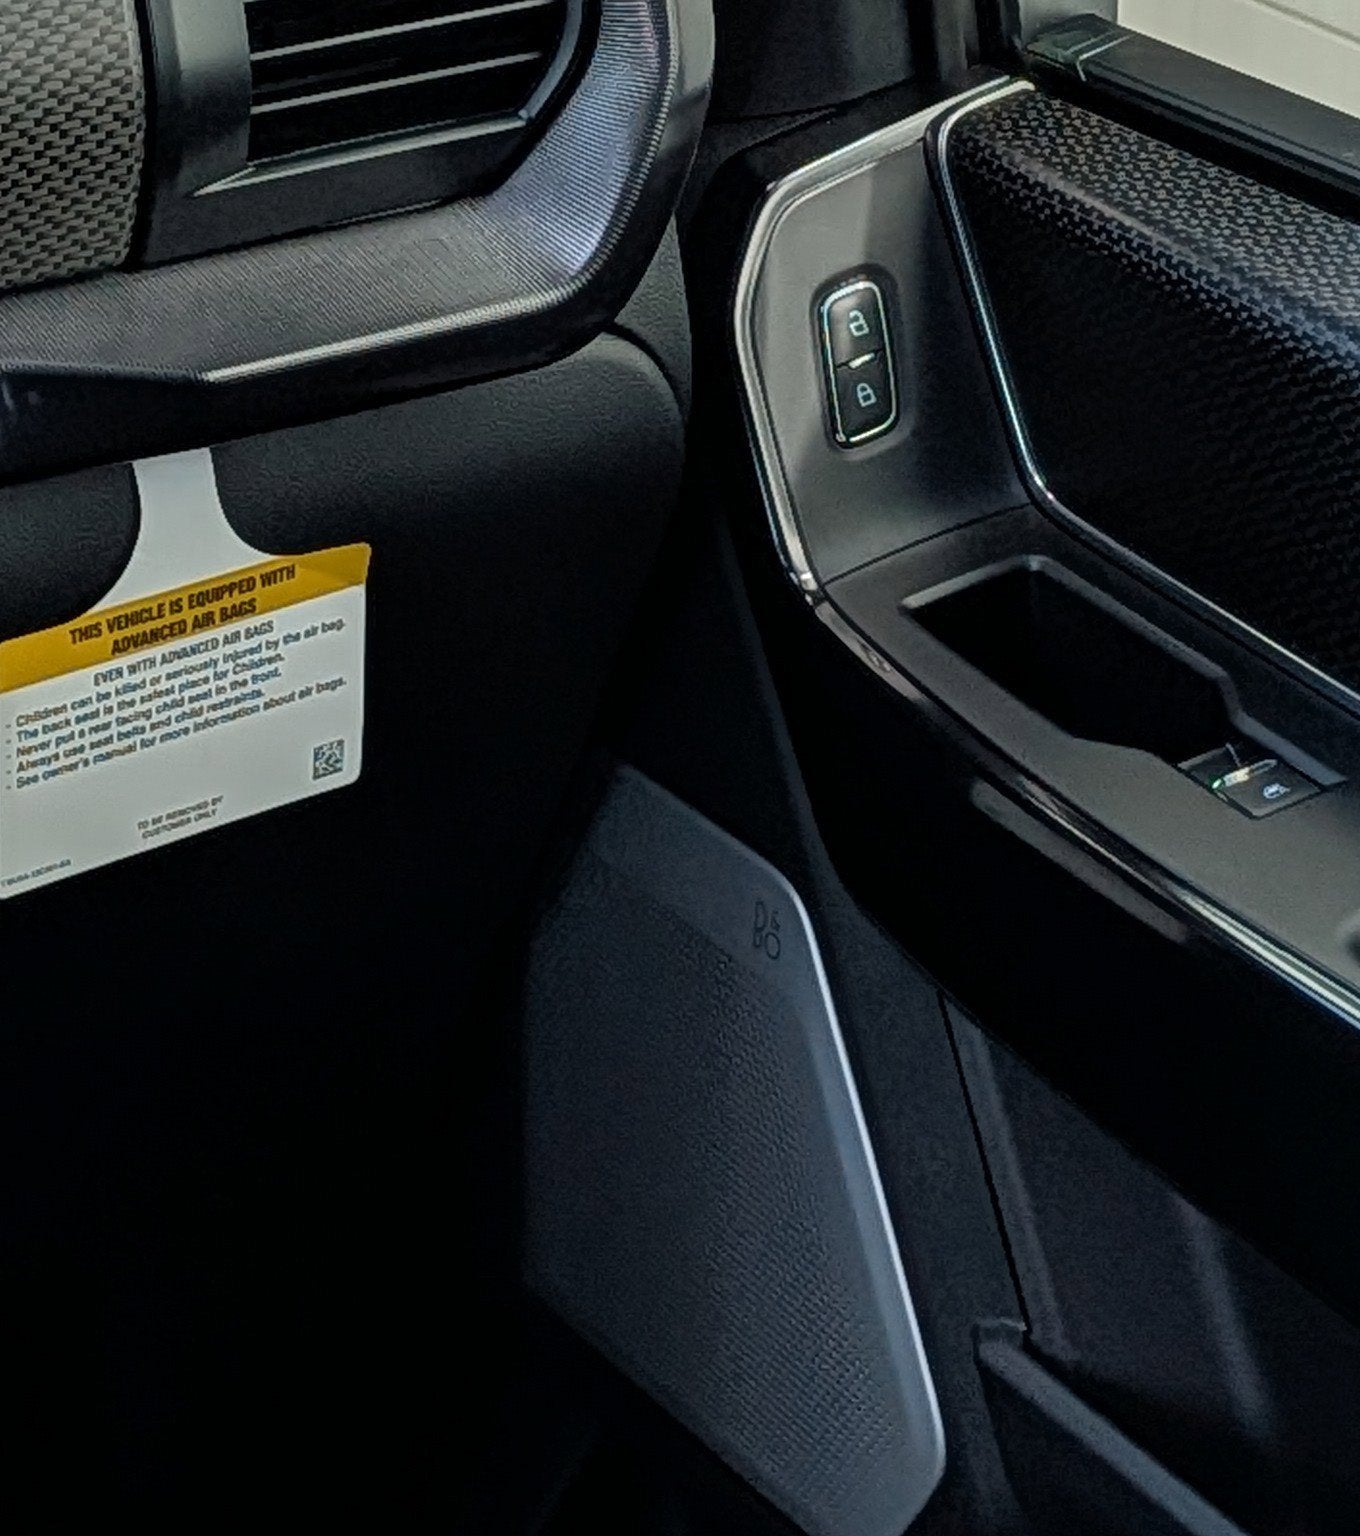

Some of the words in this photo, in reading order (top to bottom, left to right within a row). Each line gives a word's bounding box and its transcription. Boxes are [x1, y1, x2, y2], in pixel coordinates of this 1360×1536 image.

[69, 623, 102, 645] THIS
[106, 603, 166, 633] VEHICLE
[169, 597, 183, 615] IS
[188, 576, 256, 609] EQUIPPED
[260, 564, 295, 588] WITH
[111, 619, 187, 655] ADVANCED
[192, 611, 215, 630] AIR
[219, 598, 257, 622] BAGS
[16, 704, 68, 727] Children
[71, 696, 92, 712] can
[96, 688, 111, 702] be
[115, 678, 146, 697] killed
[150, 674, 162, 686] or
[165, 655, 219, 681] seriously
[223, 644, 262, 664] injured
[265, 639, 279, 652] by
[283, 633, 300, 645] the
[304, 625, 319, 639] air
[322, 618, 345, 634] bag.
[128, 655, 157, 677] WITH
[160, 638, 219, 666] ADVANCED
[222, 630, 240, 648] AIR
[245, 620, 274, 640] BAGS
[17, 729, 38, 741] The
[42, 719, 71, 735] back
[74, 711, 100, 726] seat
[103, 705, 114, 715] is
[117, 697, 136, 712] the
[140, 685, 175, 705] safest
[178, 675, 209, 695] place
[213, 670, 229, 682] for
[17, 740, 51, 757] Never
[55, 731, 75, 749] put
[78, 730, 85, 739] a
[89, 721, 112, 735] rear
[116, 708, 152, 726] facing
[155, 696, 184, 714] child
[188, 690, 212, 704] seat
[215, 685, 226, 695] in
[230, 678, 248, 691] the
[17, 776, 39, 788] See
[42, 757, 89, 781] owner's
[93, 743, 137, 764] manual
[140, 736, 156, 750] for
[159, 726, 190, 743] more
[193, 705, 259, 733] information
[263, 693, 295, 711] about
[298, 686, 313, 699] air
[17, 753, 59, 773] Always
[63, 744, 85, 757] use
[90, 734, 114, 750] seat
[117, 725, 146, 741] belts
[150, 717, 171, 732] and
[175, 705, 203, 724] child
